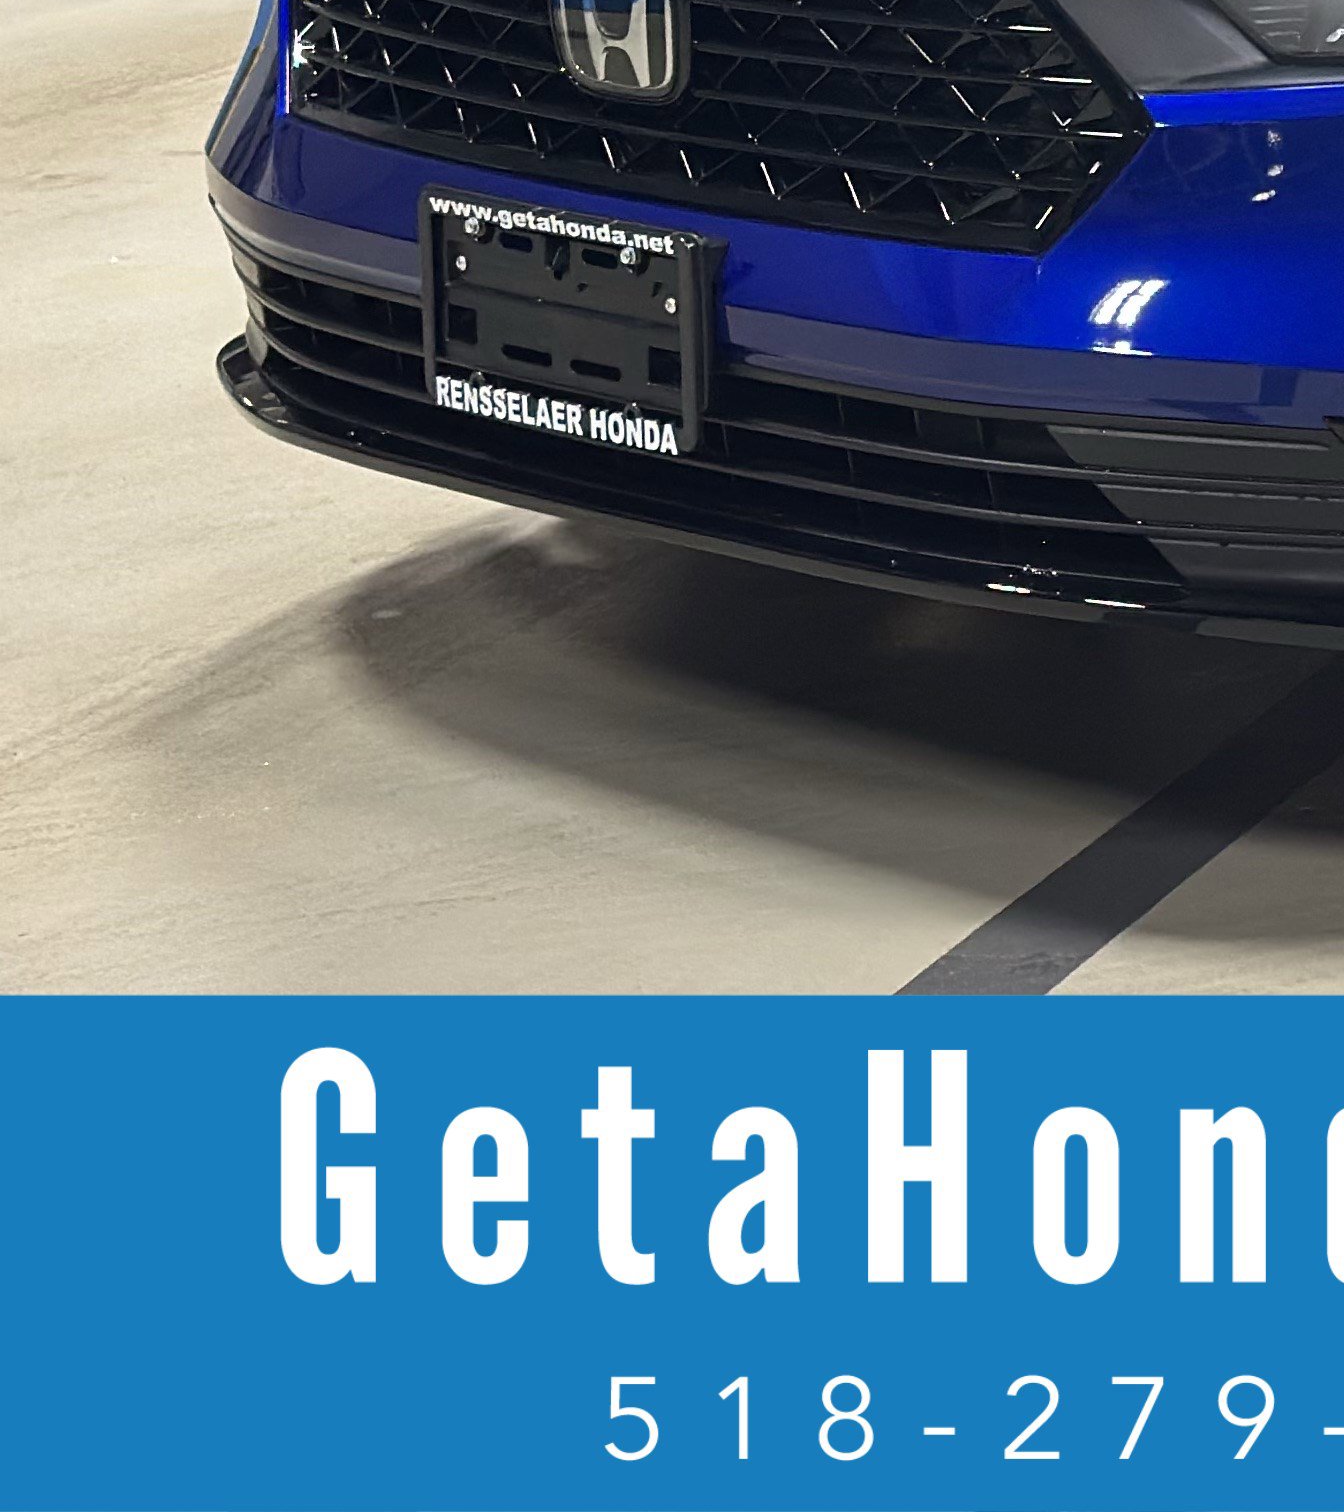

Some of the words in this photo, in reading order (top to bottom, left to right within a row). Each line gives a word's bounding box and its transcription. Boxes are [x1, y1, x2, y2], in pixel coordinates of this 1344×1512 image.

[428, 196, 675, 256] www.getahonda.net
[435, 375, 584, 436] RENSSELAER
[589, 407, 679, 456] HONDA
